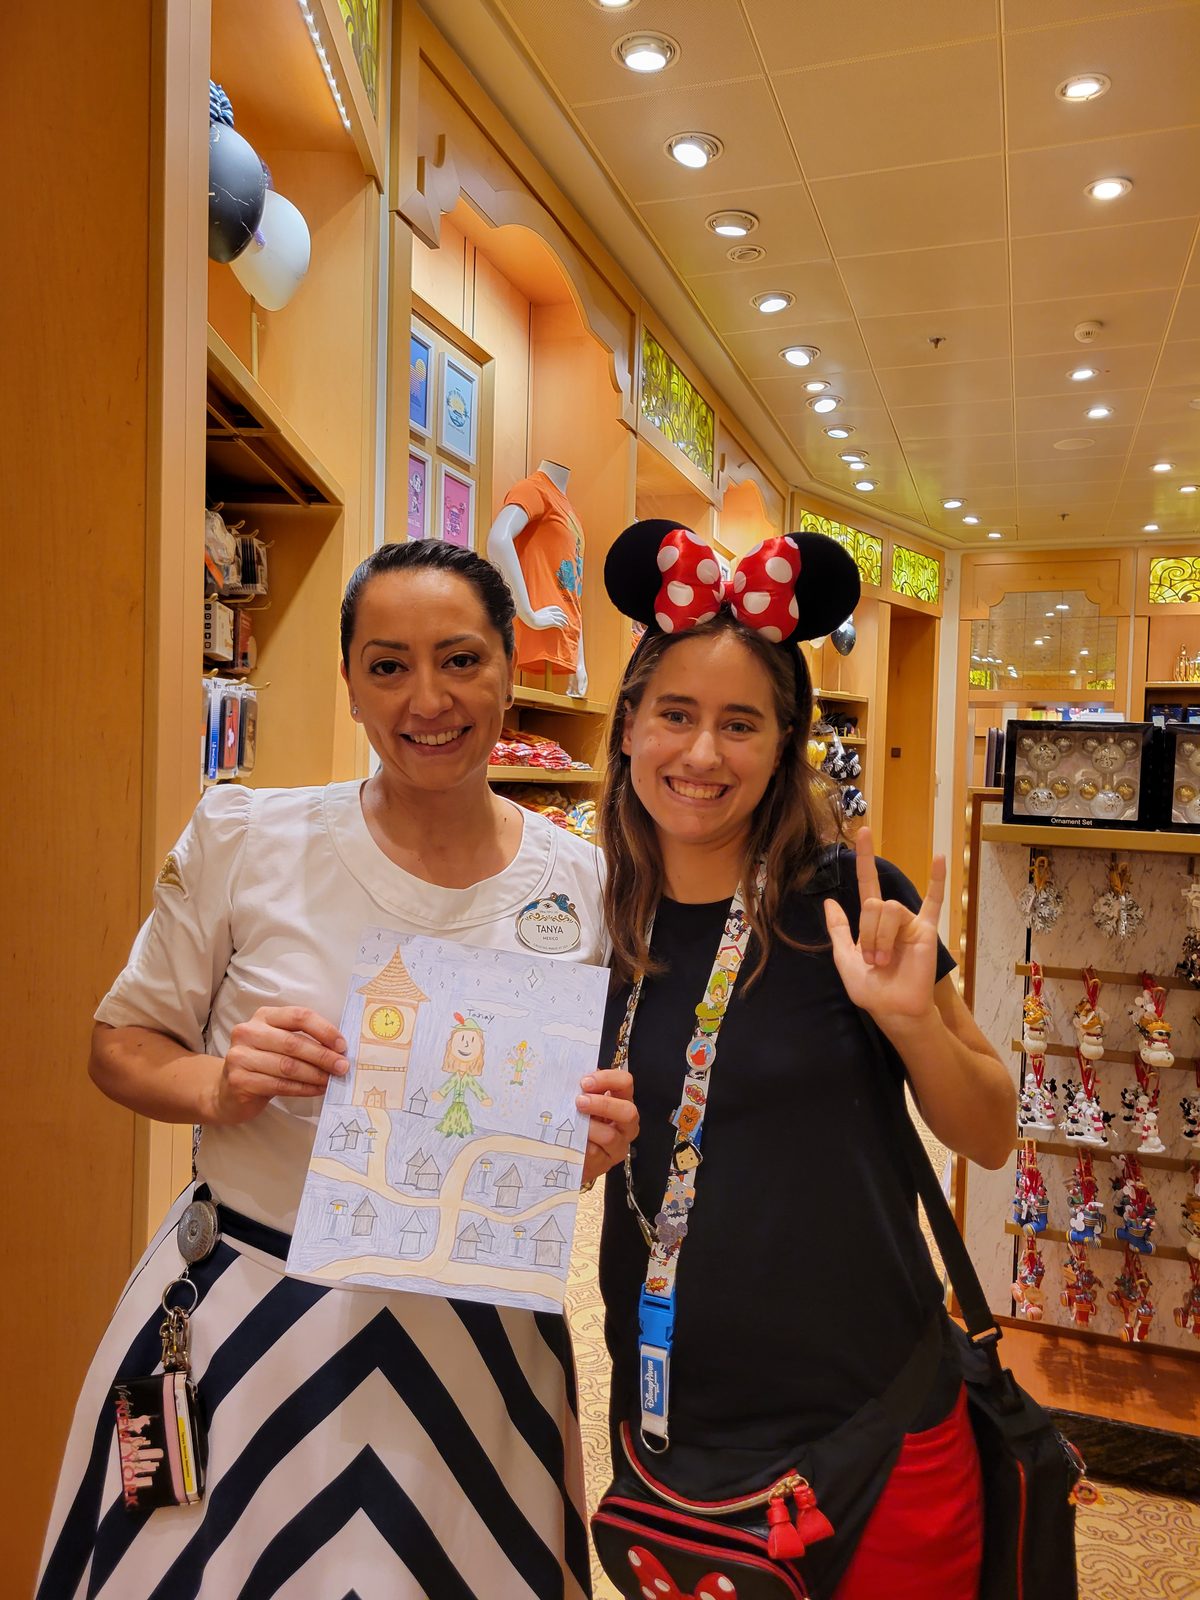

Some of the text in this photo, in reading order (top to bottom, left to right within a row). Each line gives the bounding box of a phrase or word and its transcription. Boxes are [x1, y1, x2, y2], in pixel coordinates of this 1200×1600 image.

[536, 924, 564, 934] TANYA
[116, 1400, 140, 1505] NEW YORK
